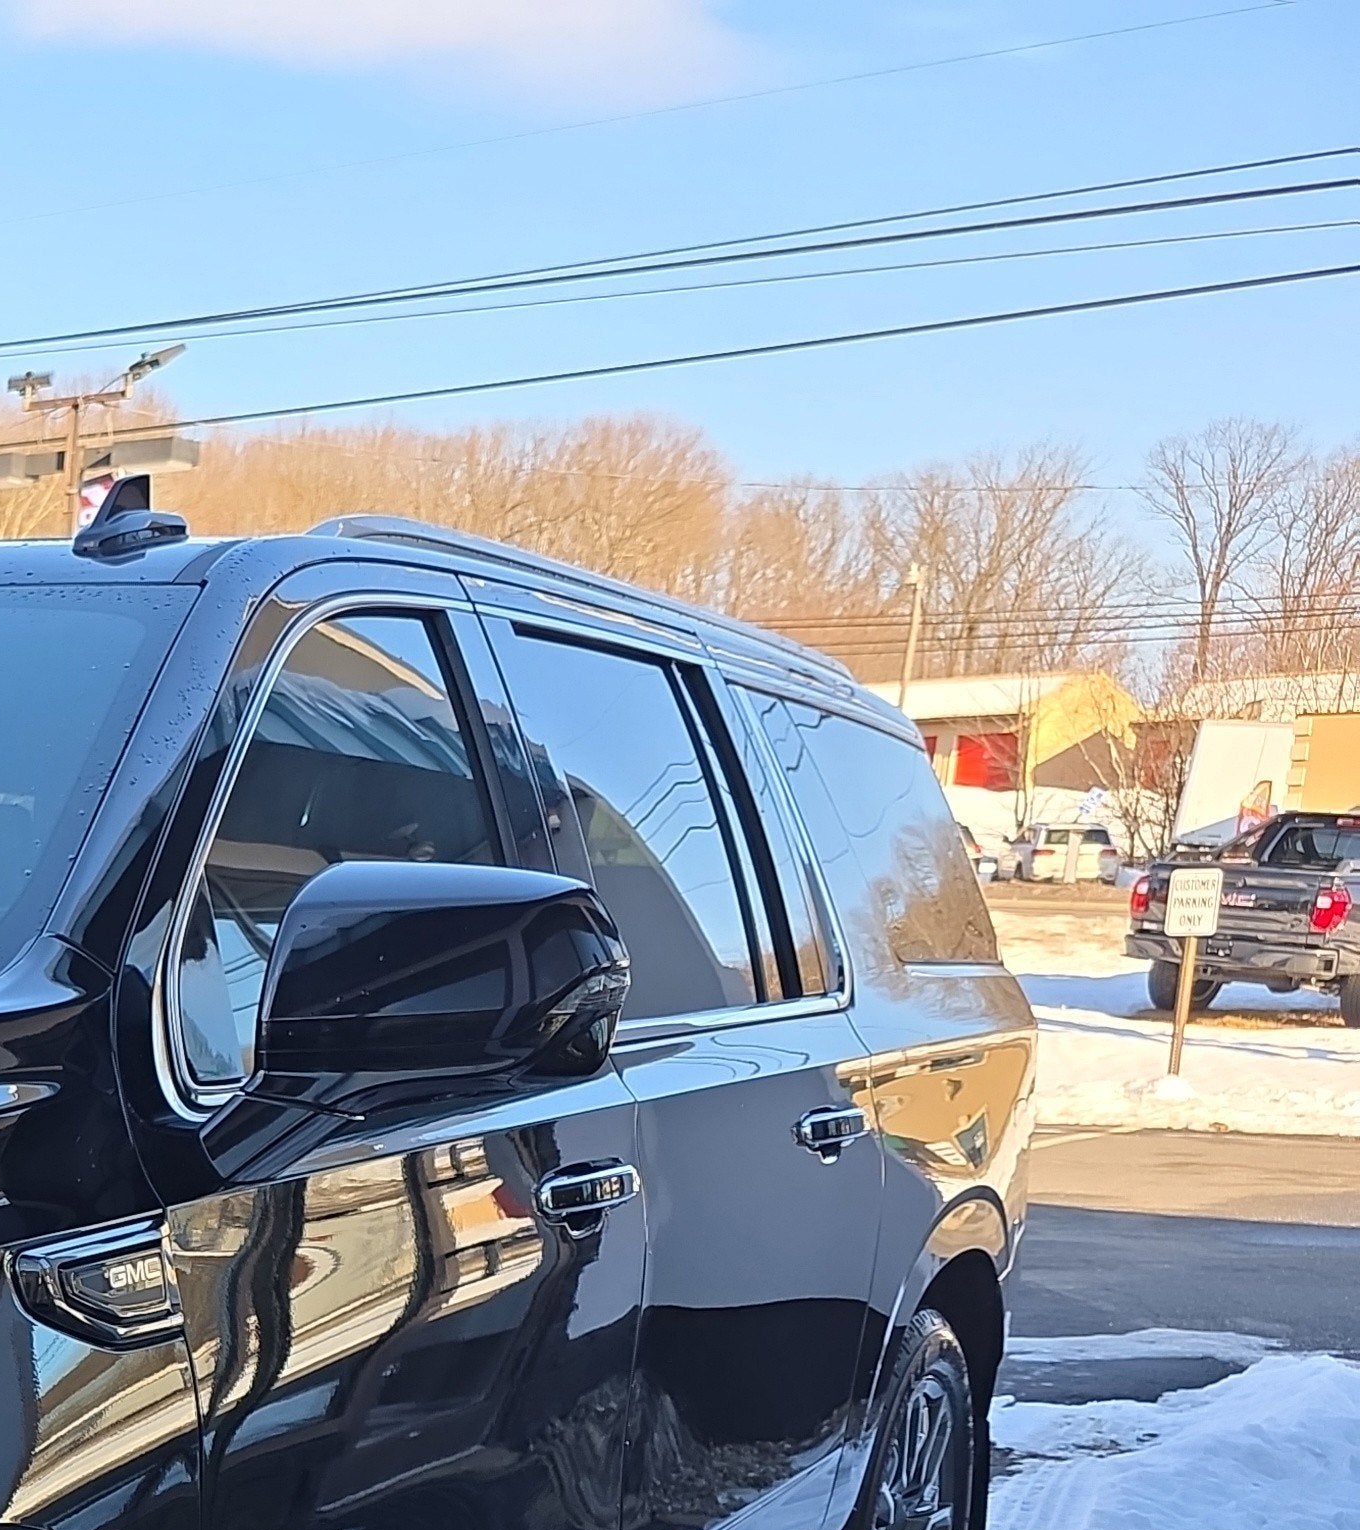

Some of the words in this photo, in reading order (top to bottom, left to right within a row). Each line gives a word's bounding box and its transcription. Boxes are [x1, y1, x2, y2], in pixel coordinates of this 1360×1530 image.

[1174, 879, 1217, 892] CUSTOMER
[1172, 897, 1214, 909] PARKING
[1178, 914, 1204, 927] ONLY
[109, 1257, 162, 1289] GMC
